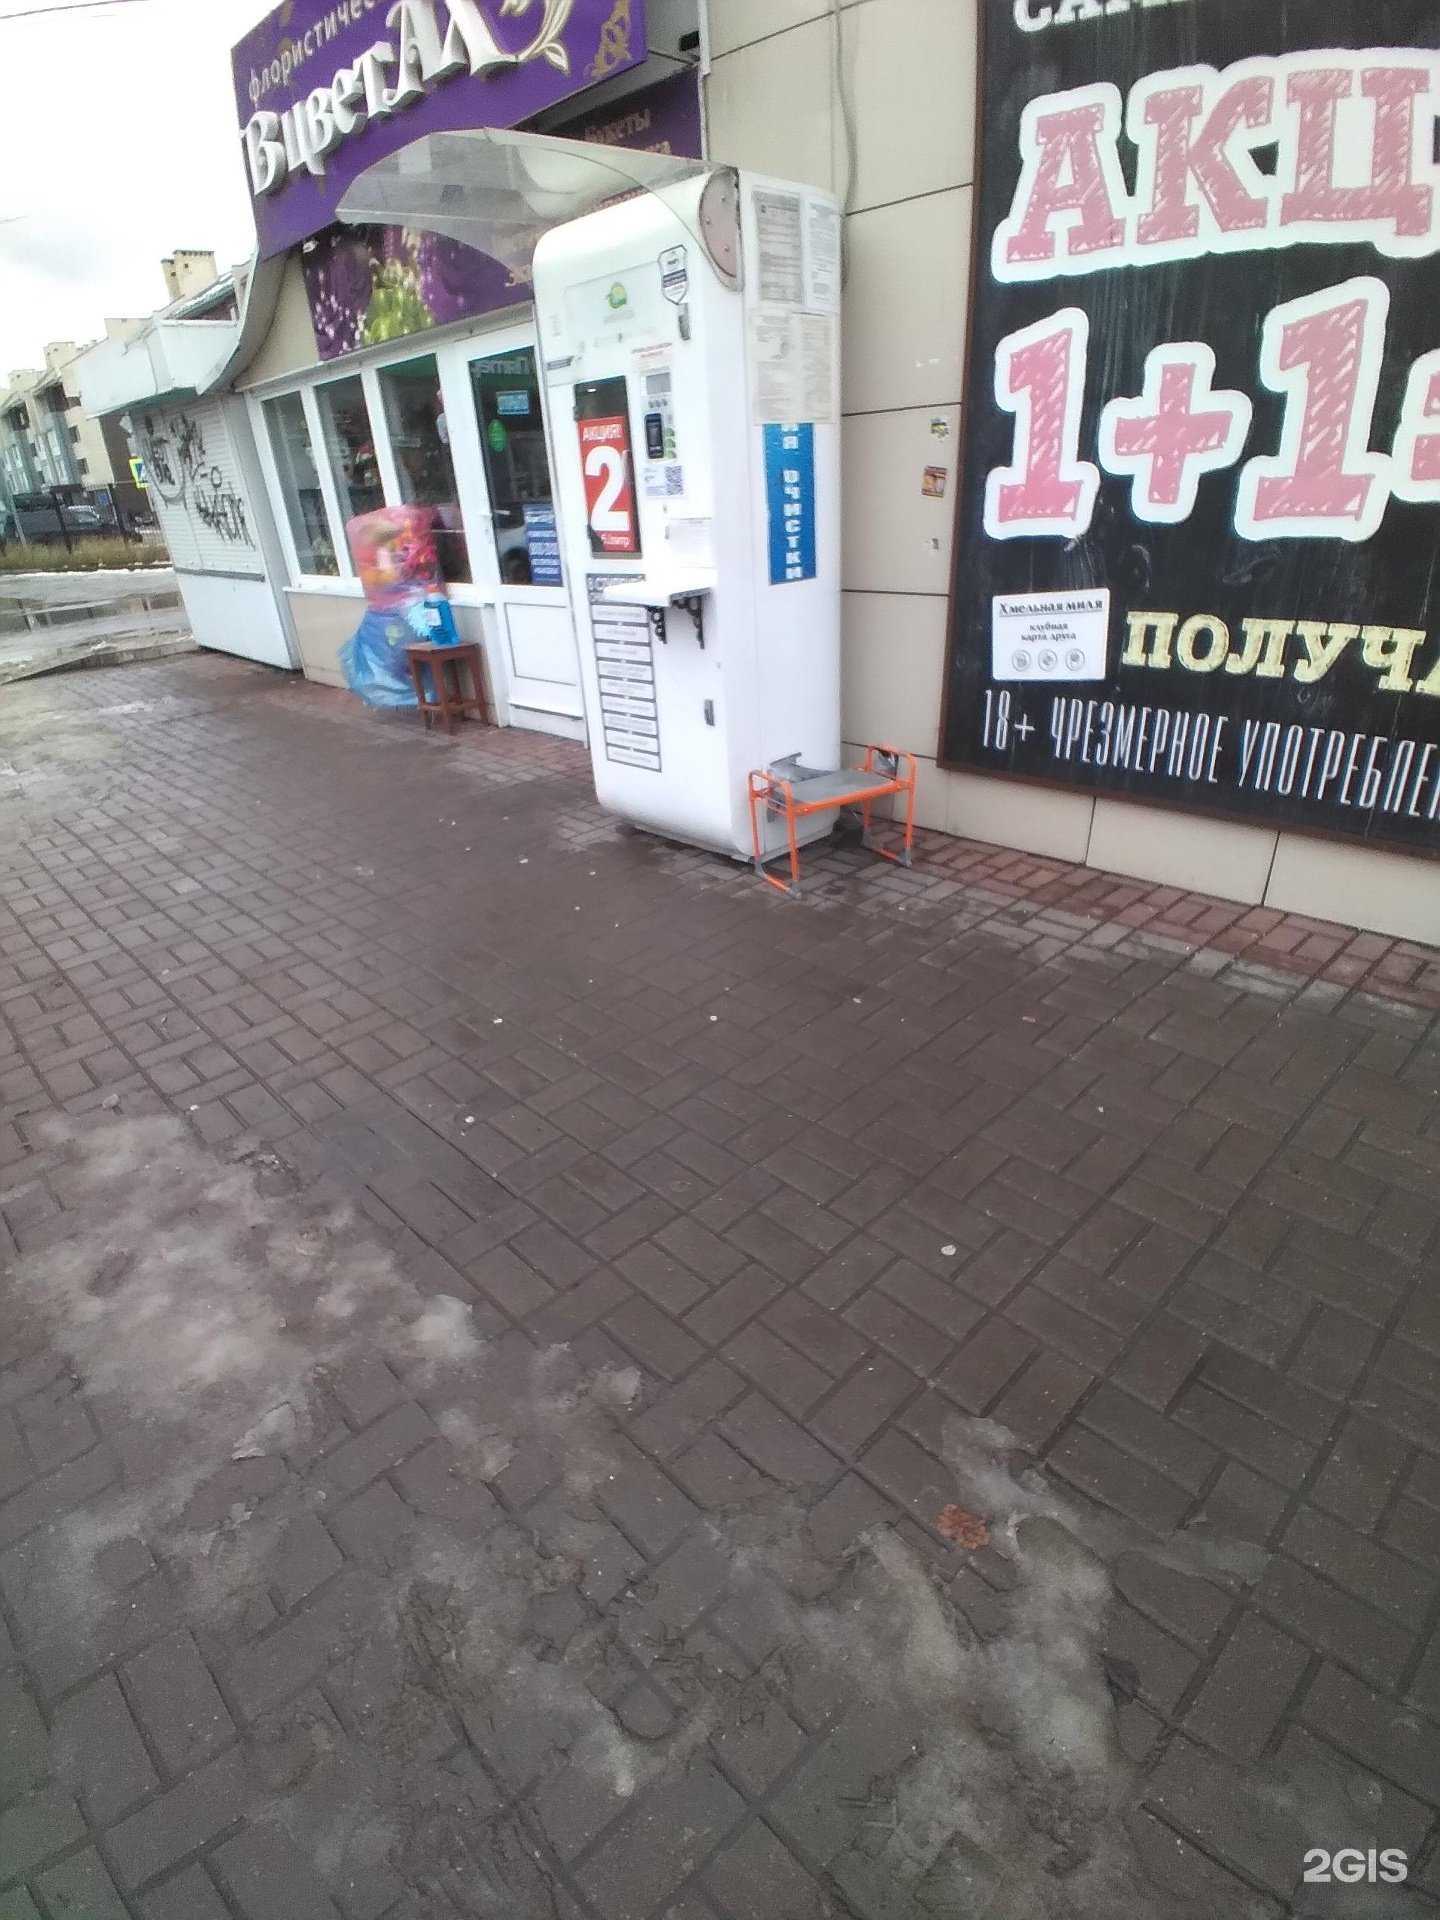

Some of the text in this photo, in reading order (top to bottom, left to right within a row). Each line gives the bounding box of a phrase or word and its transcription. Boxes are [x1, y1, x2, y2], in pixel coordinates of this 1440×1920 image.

[584, 445, 631, 532] 2
[982, 689, 1036, 750] 18+
[1051, 696, 1230, 784] ЧРЕЗМЕРНОЕ
